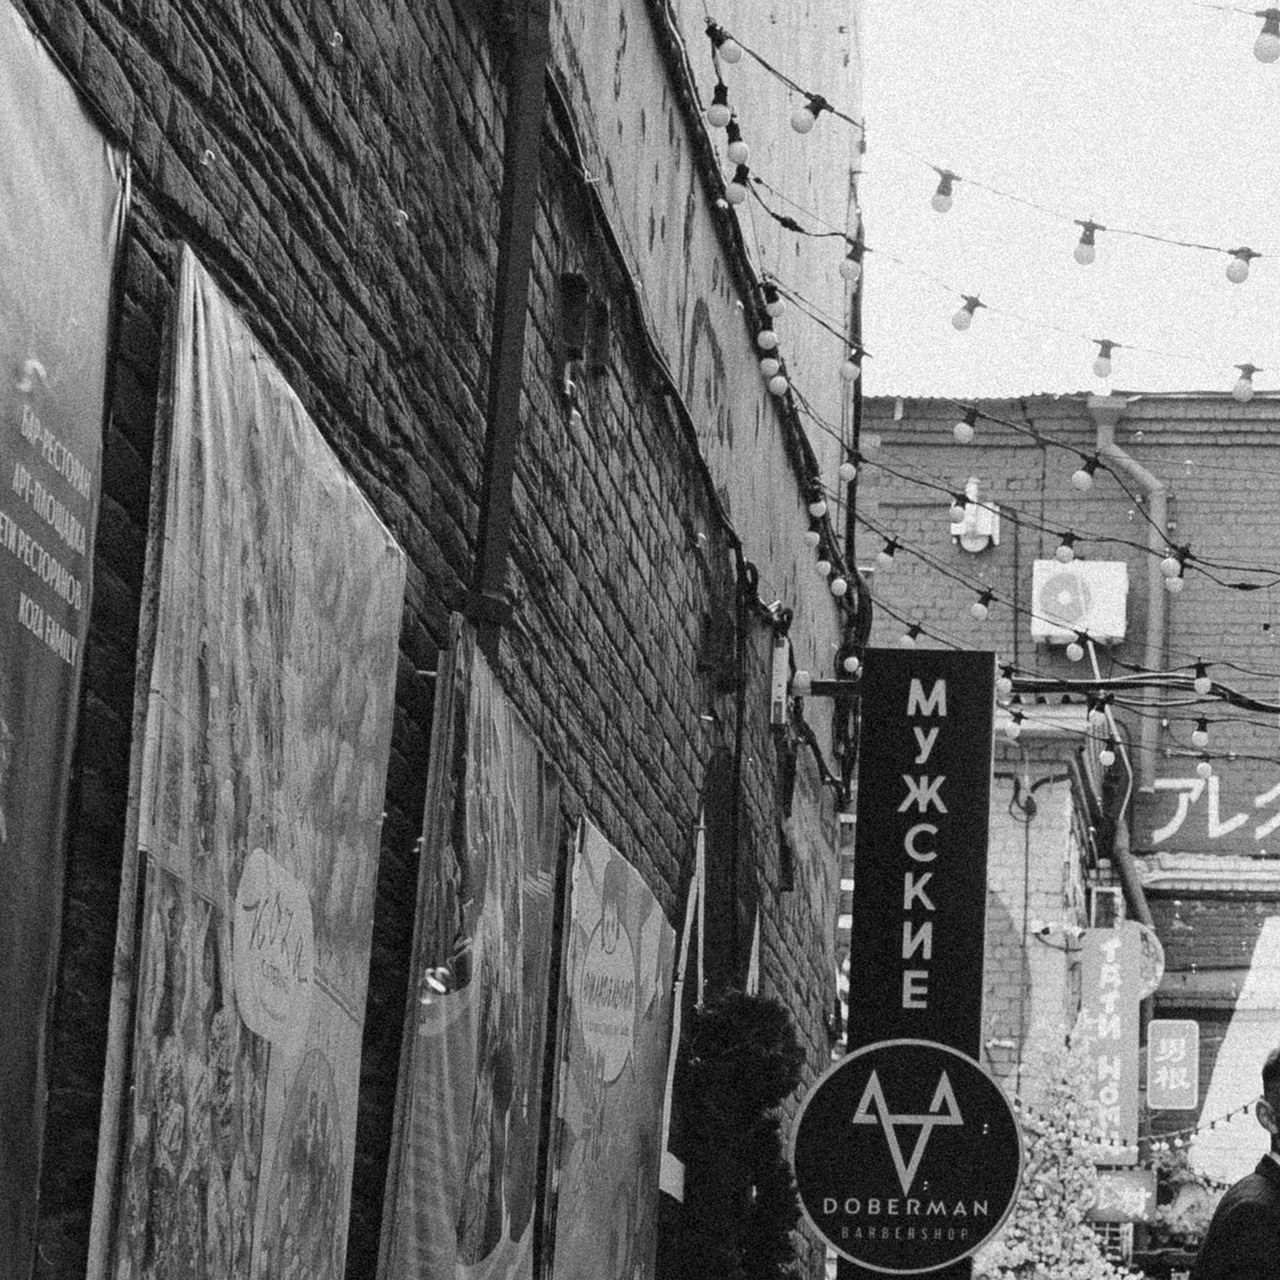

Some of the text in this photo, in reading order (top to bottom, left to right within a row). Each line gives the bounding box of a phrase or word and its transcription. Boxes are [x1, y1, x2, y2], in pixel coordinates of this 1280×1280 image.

[21, 404, 91, 501] БАР-РЕСТОРАН
[17, 528, 81, 610] РЕСТОРАНОВ
[898, 677, 948, 1008] МУЖСКИЕ
[824, 1197, 988, 1216] DOBERMAN
[842, 1226, 969, 1241] BARBERSHOP
